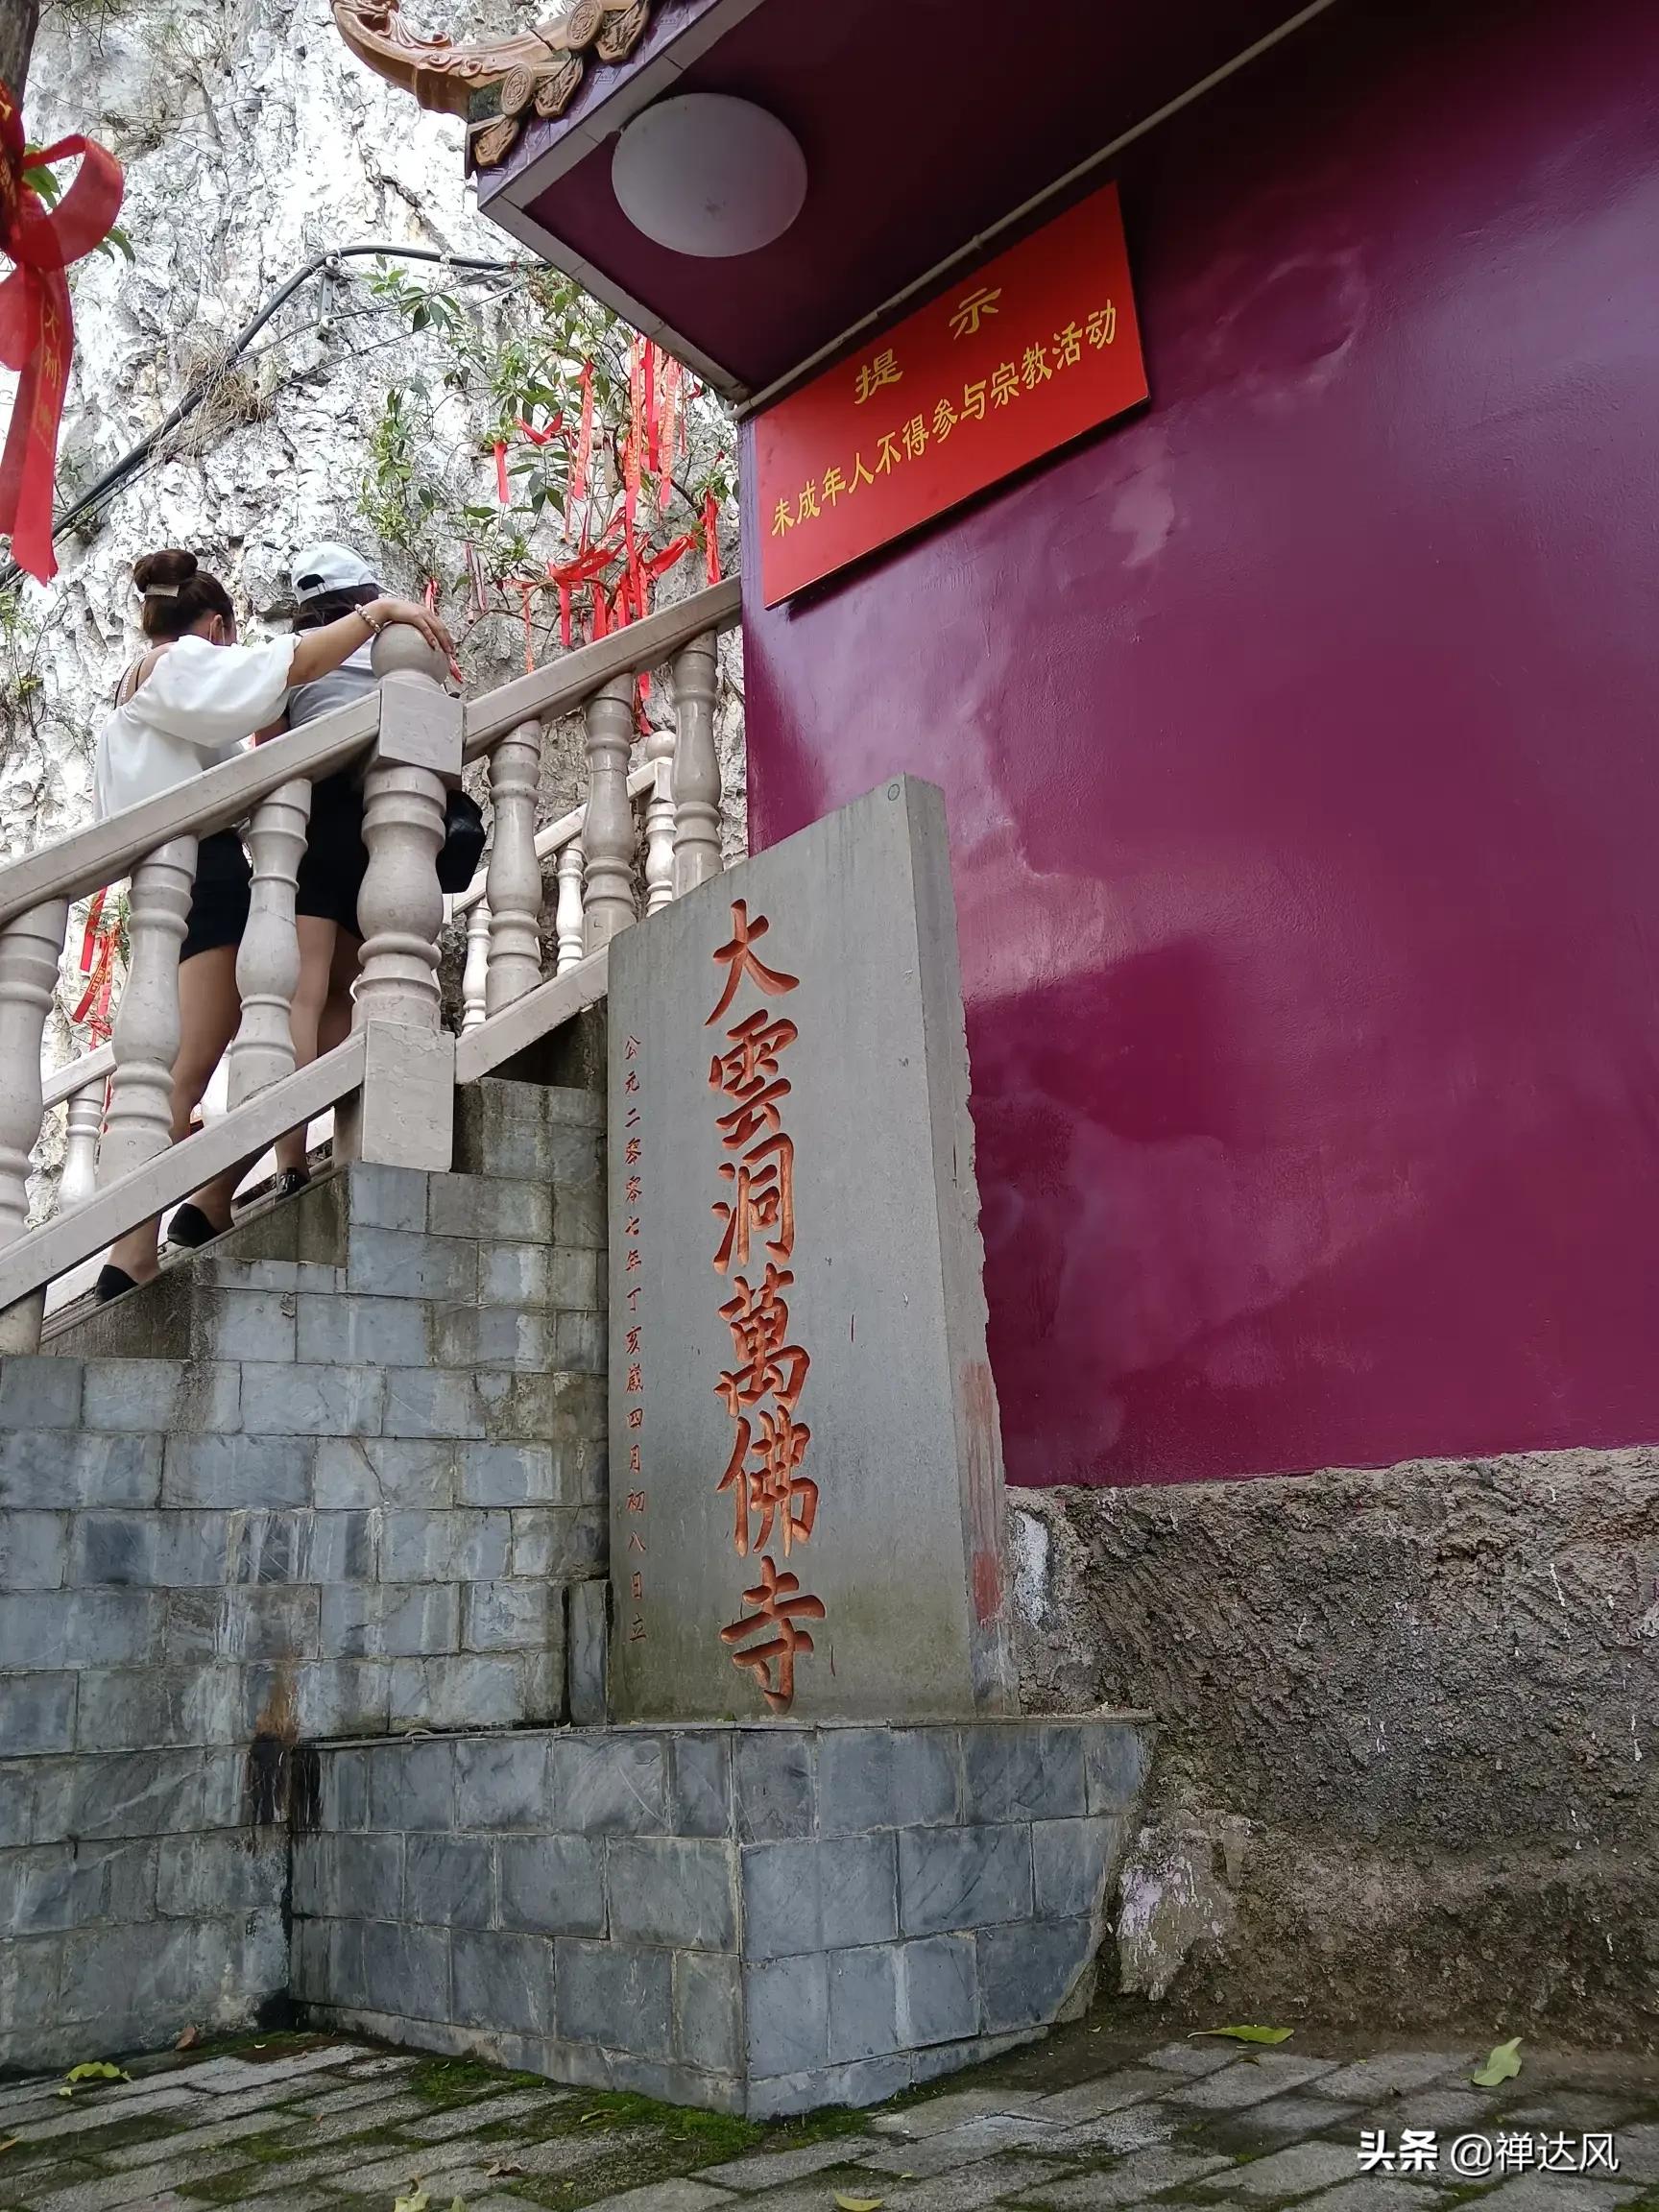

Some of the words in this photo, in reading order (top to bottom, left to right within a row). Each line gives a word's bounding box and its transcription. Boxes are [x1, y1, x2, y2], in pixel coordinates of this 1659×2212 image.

[772, 300, 1116, 537] 未成年人不得参与宗教活动
[854, 288, 1000, 404] 提示
[704, 899, 827, 1716] 大雲洞萬佛寺
